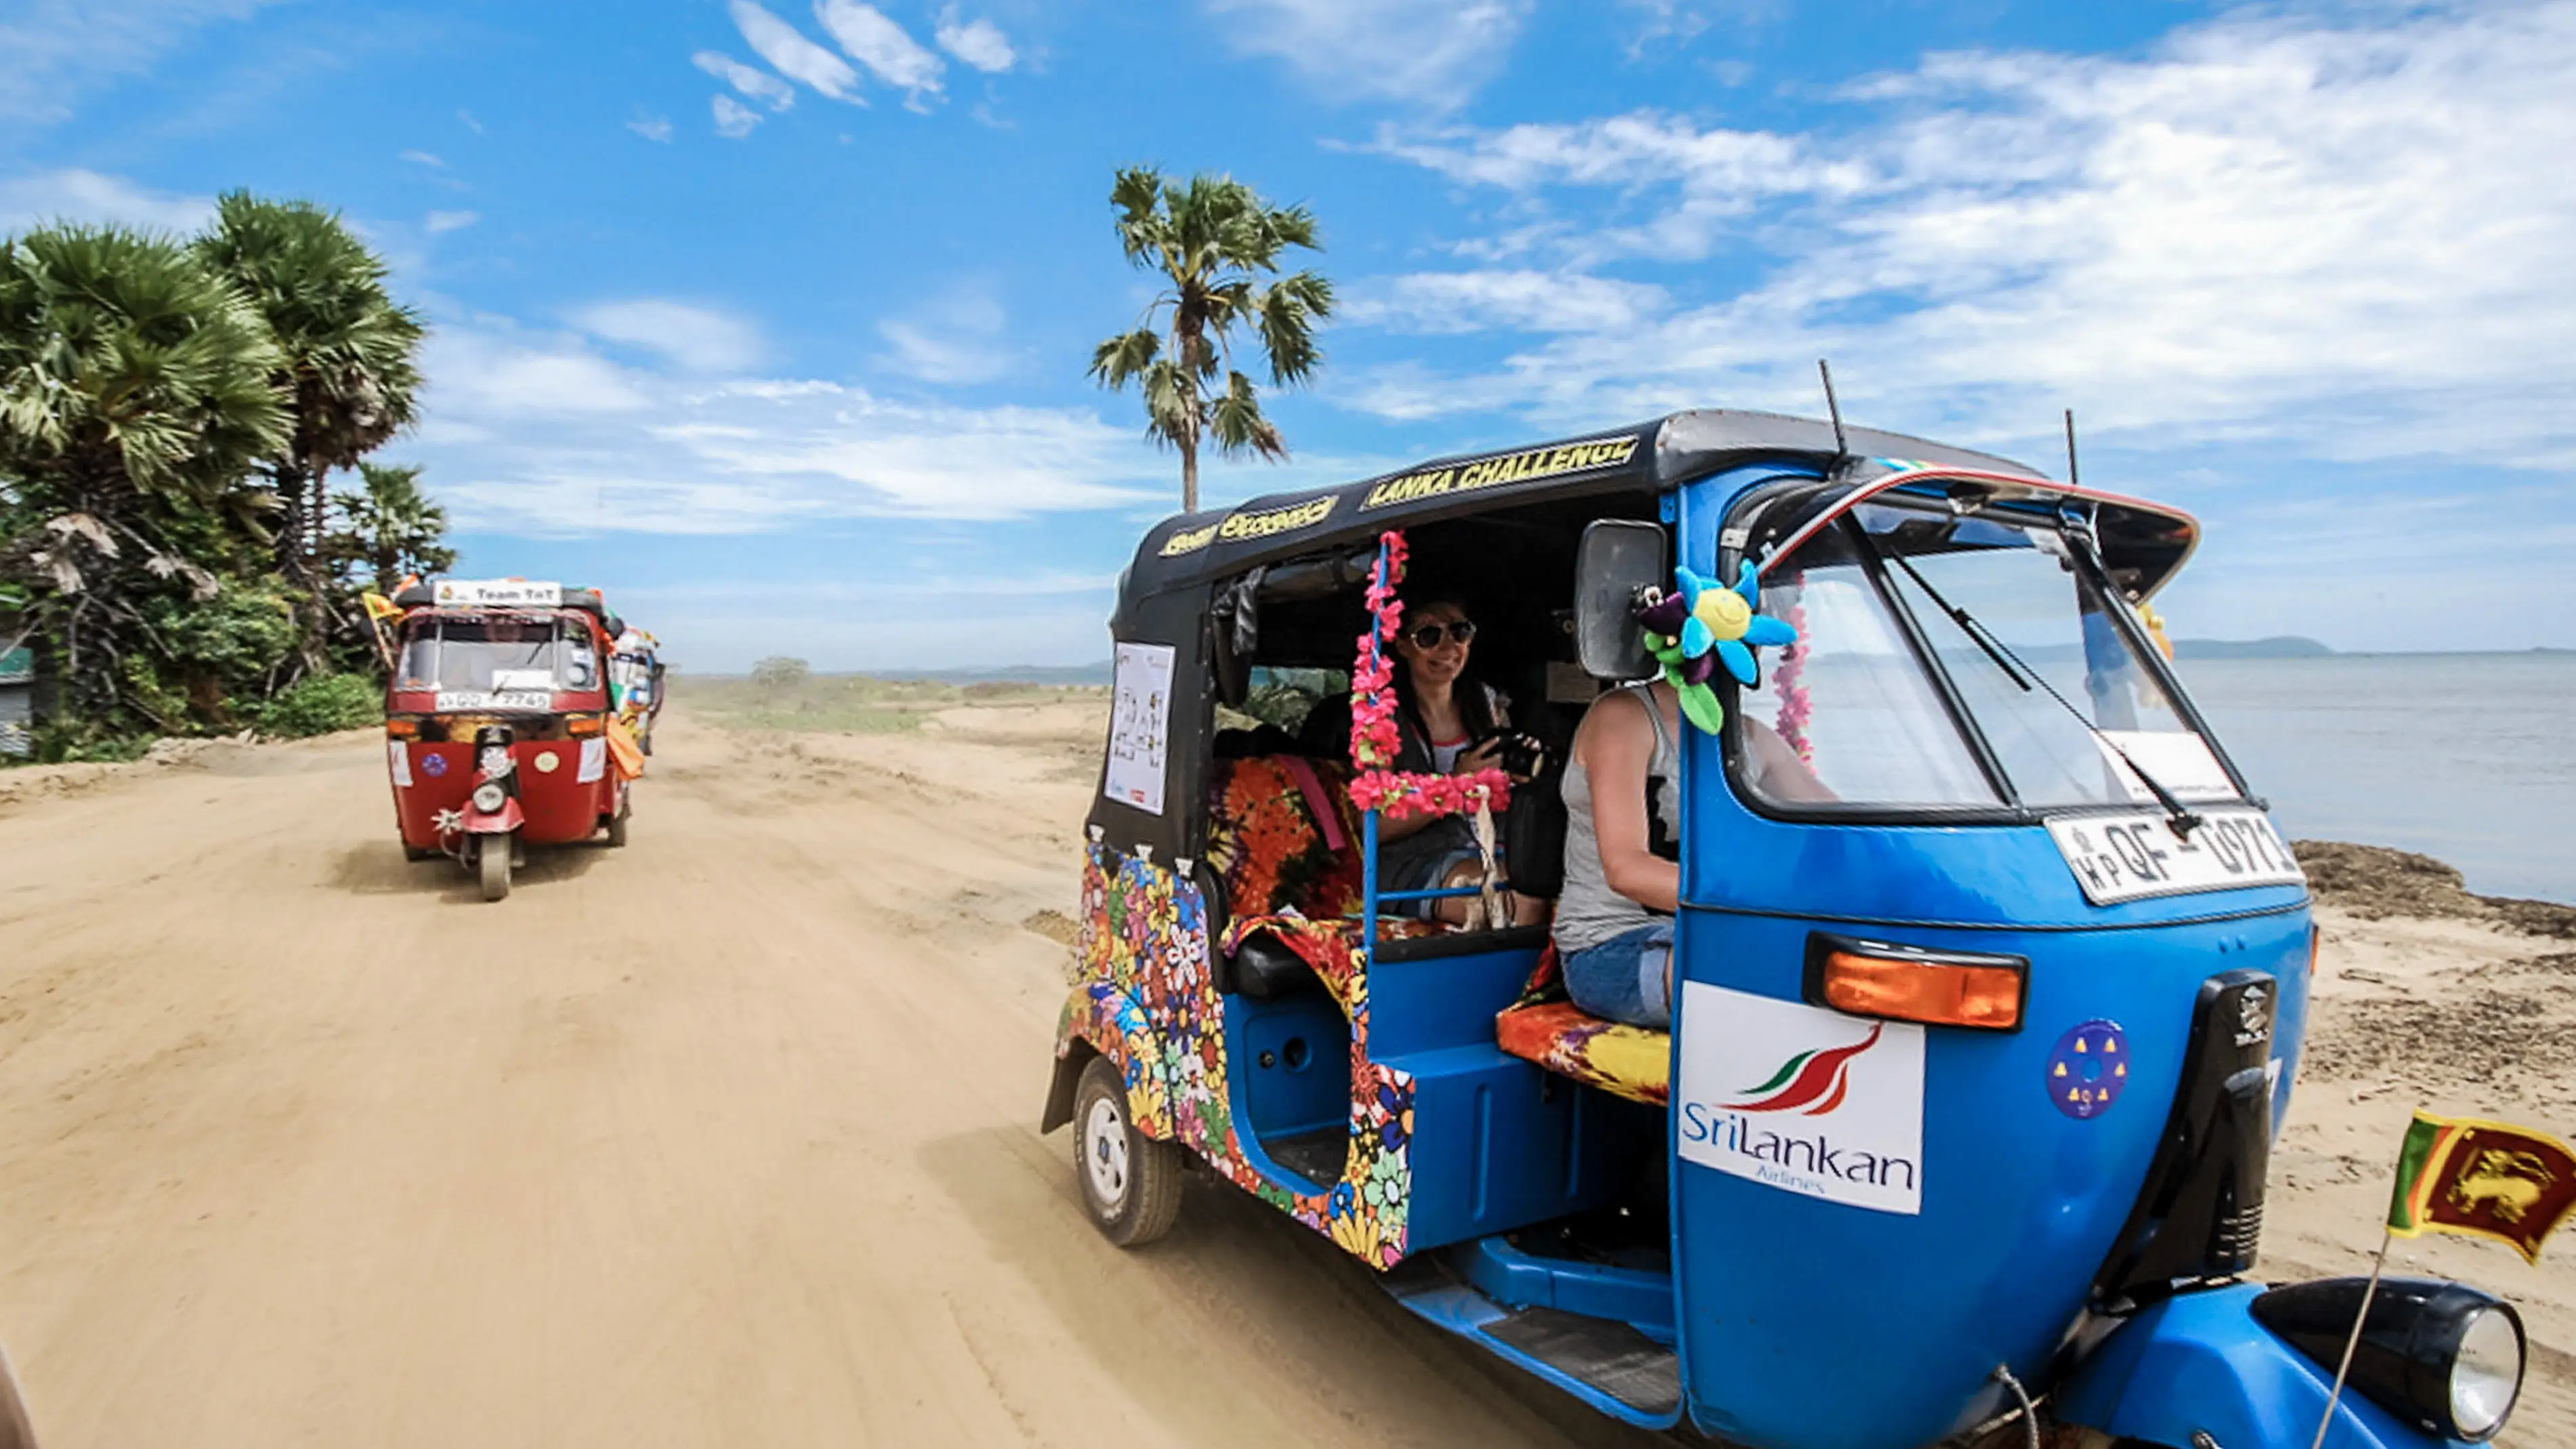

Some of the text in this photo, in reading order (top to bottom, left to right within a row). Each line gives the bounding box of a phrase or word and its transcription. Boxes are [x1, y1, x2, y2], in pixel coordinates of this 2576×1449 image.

[1366, 441, 1636, 508] LANKA CHALLENGE
[477, 588, 521, 600] Team
[1682, 1103, 1914, 1191] SriLankan
[1754, 1164, 1826, 1195] Airlines
